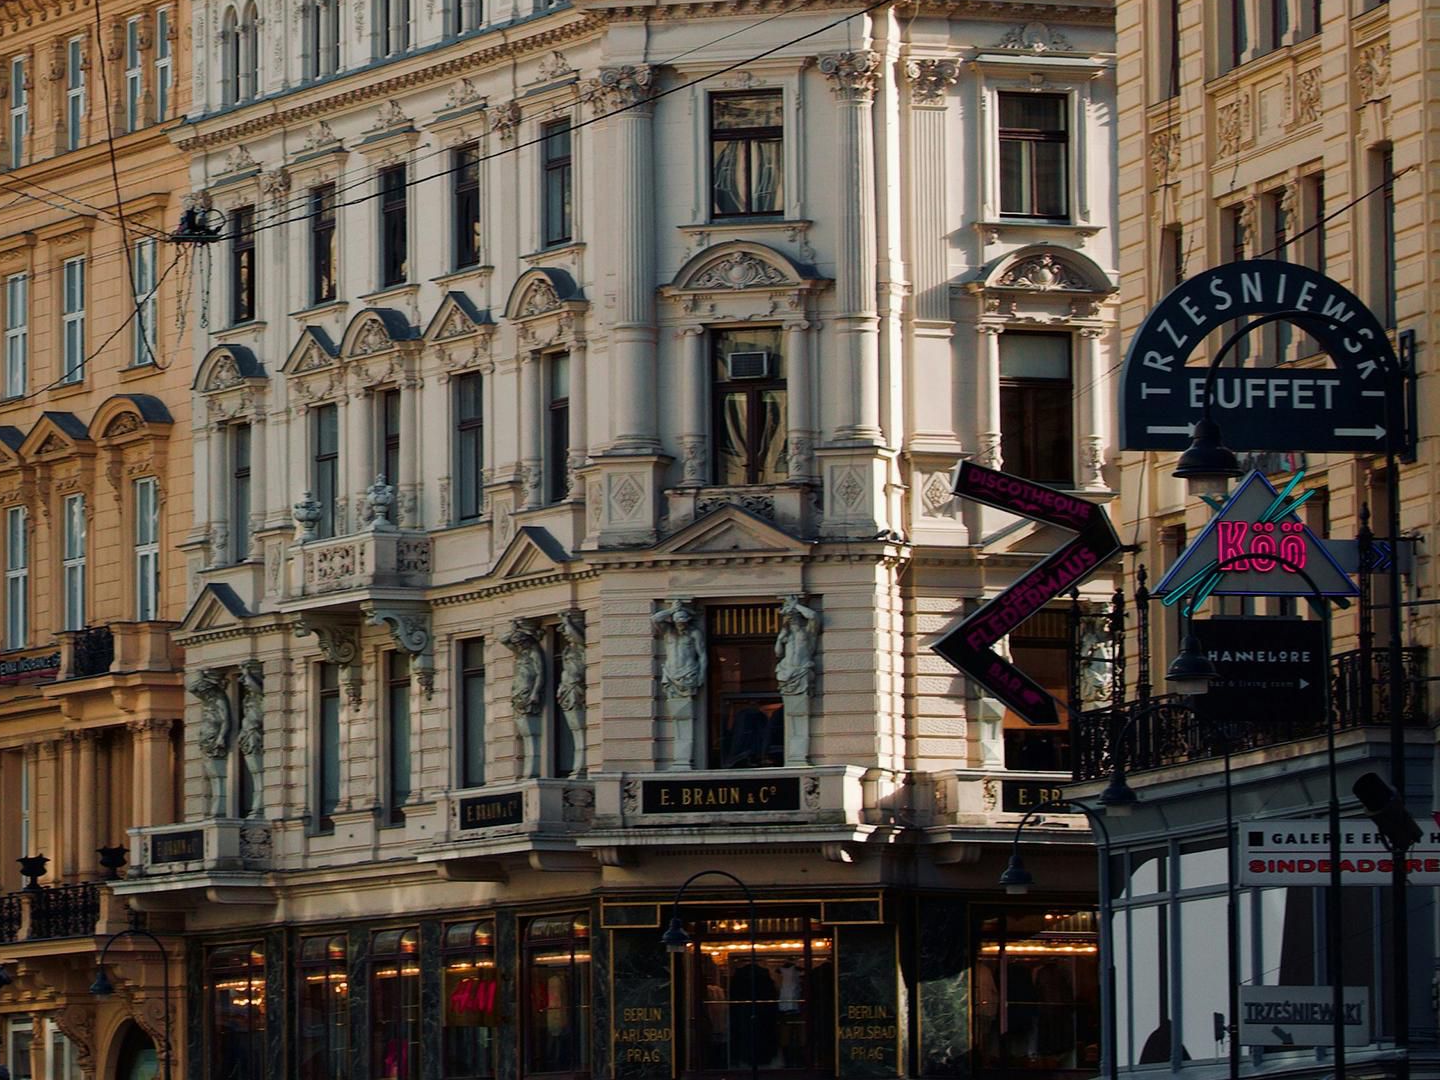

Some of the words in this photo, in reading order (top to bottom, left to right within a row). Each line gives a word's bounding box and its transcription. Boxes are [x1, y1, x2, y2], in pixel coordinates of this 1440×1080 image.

[1188, 377, 1341, 410] BUFFET
[967, 467, 1092, 519] DISCOTHEQUE
[965, 546, 1098, 652] FLEDERMAUS
[989, 661, 1022, 692] BAR
[660, 789, 675, 806] E.
[681, 787, 740, 805] BRAUN
[747, 792, 755, 804] &
[1272, 833, 1355, 844] GALERE
[624, 1007, 662, 1022] BERLIN
[848, 1004, 887, 1020] BERLIN
[1244, 1000, 1362, 1021] TRZEŚNIEWKI
[615, 1027, 672, 1043] KARLSBAD
[839, 1025, 896, 1041] KARLSBAD
[626, 1048, 661, 1064] PRAG
[850, 1046, 884, 1062] PRAG
